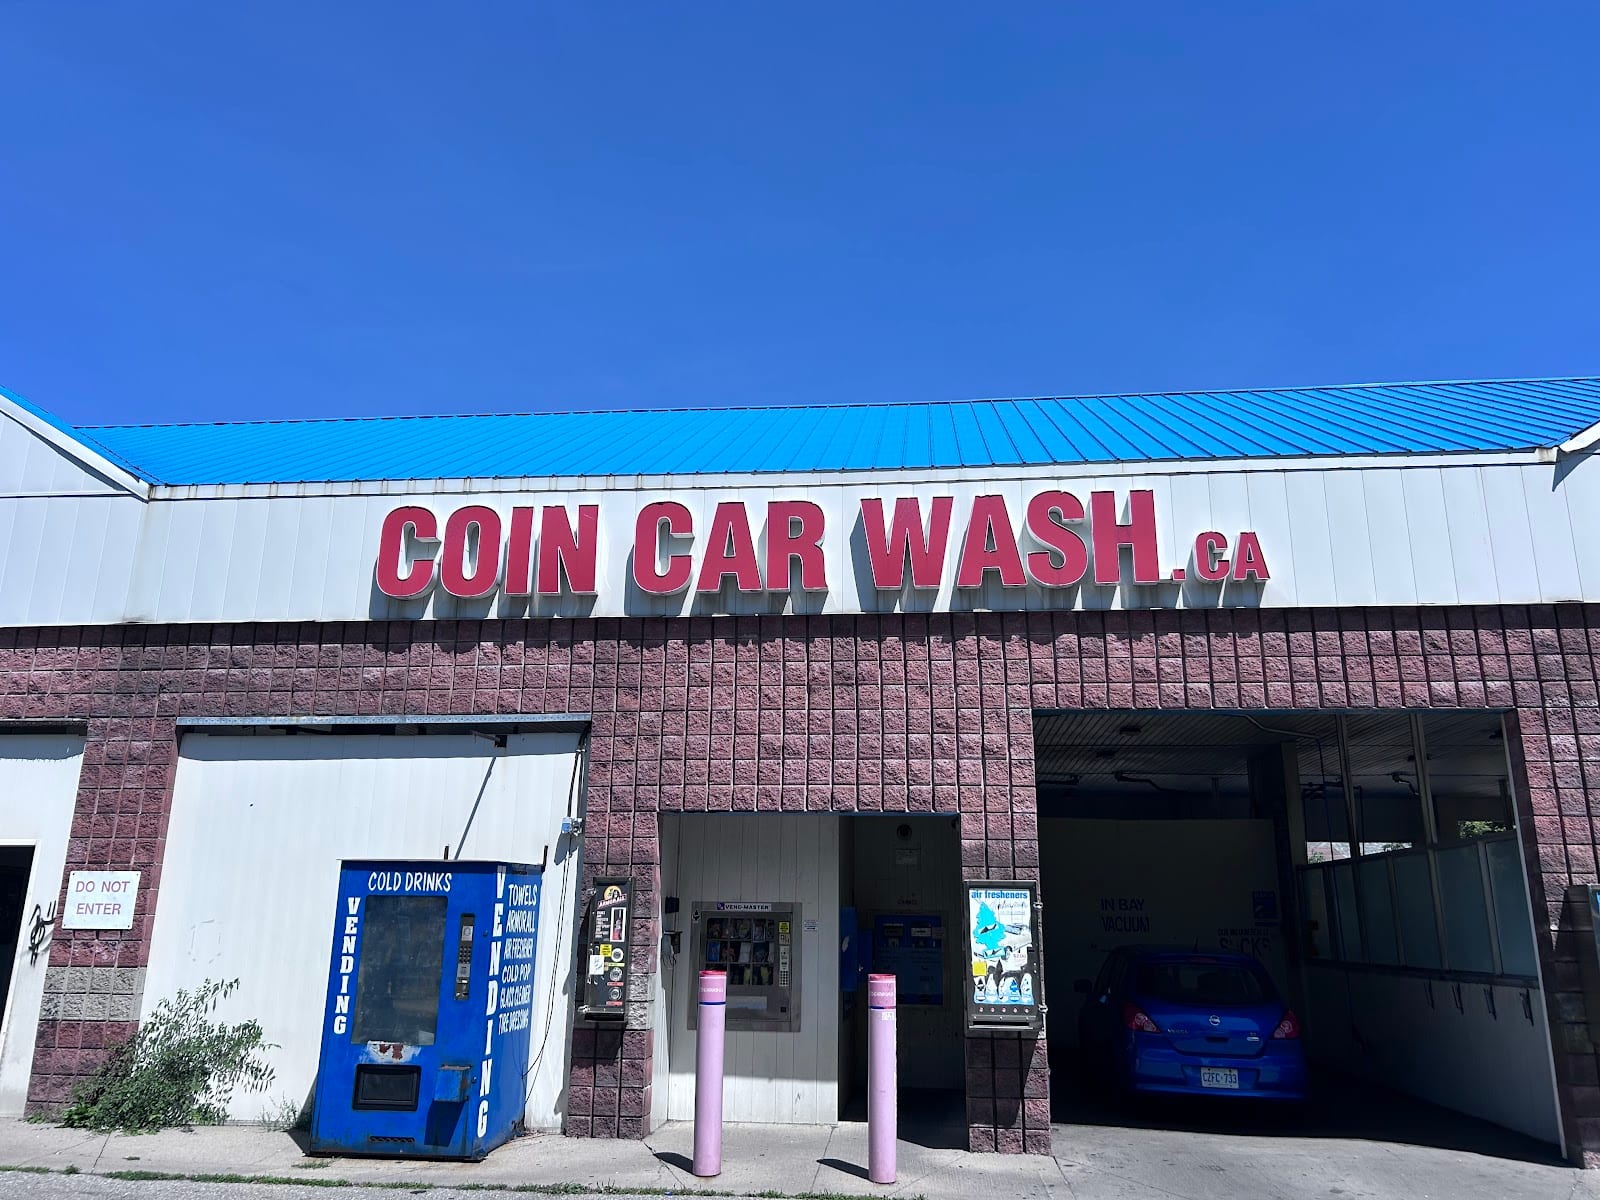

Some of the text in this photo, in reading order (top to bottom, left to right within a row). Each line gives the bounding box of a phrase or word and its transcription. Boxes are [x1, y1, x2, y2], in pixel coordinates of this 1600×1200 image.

[376, 504, 600, 598] COIN
[633, 500, 828, 594] CAR
[75, 881, 131, 893] DO NOT
[367, 872, 452, 892] COLD DRINKS
[509, 884, 538, 906] TOWELS
[971, 888, 1028, 900] air fresheners
[76, 903, 122, 915] ENTER
[1101, 898, 1145, 911] IN BAY
[1101, 916, 1151, 932] VACUUM
[333, 897, 361, 1035] VENDING
[502, 963, 532, 984] COLD POP
[477, 866, 507, 1138] VENDING
